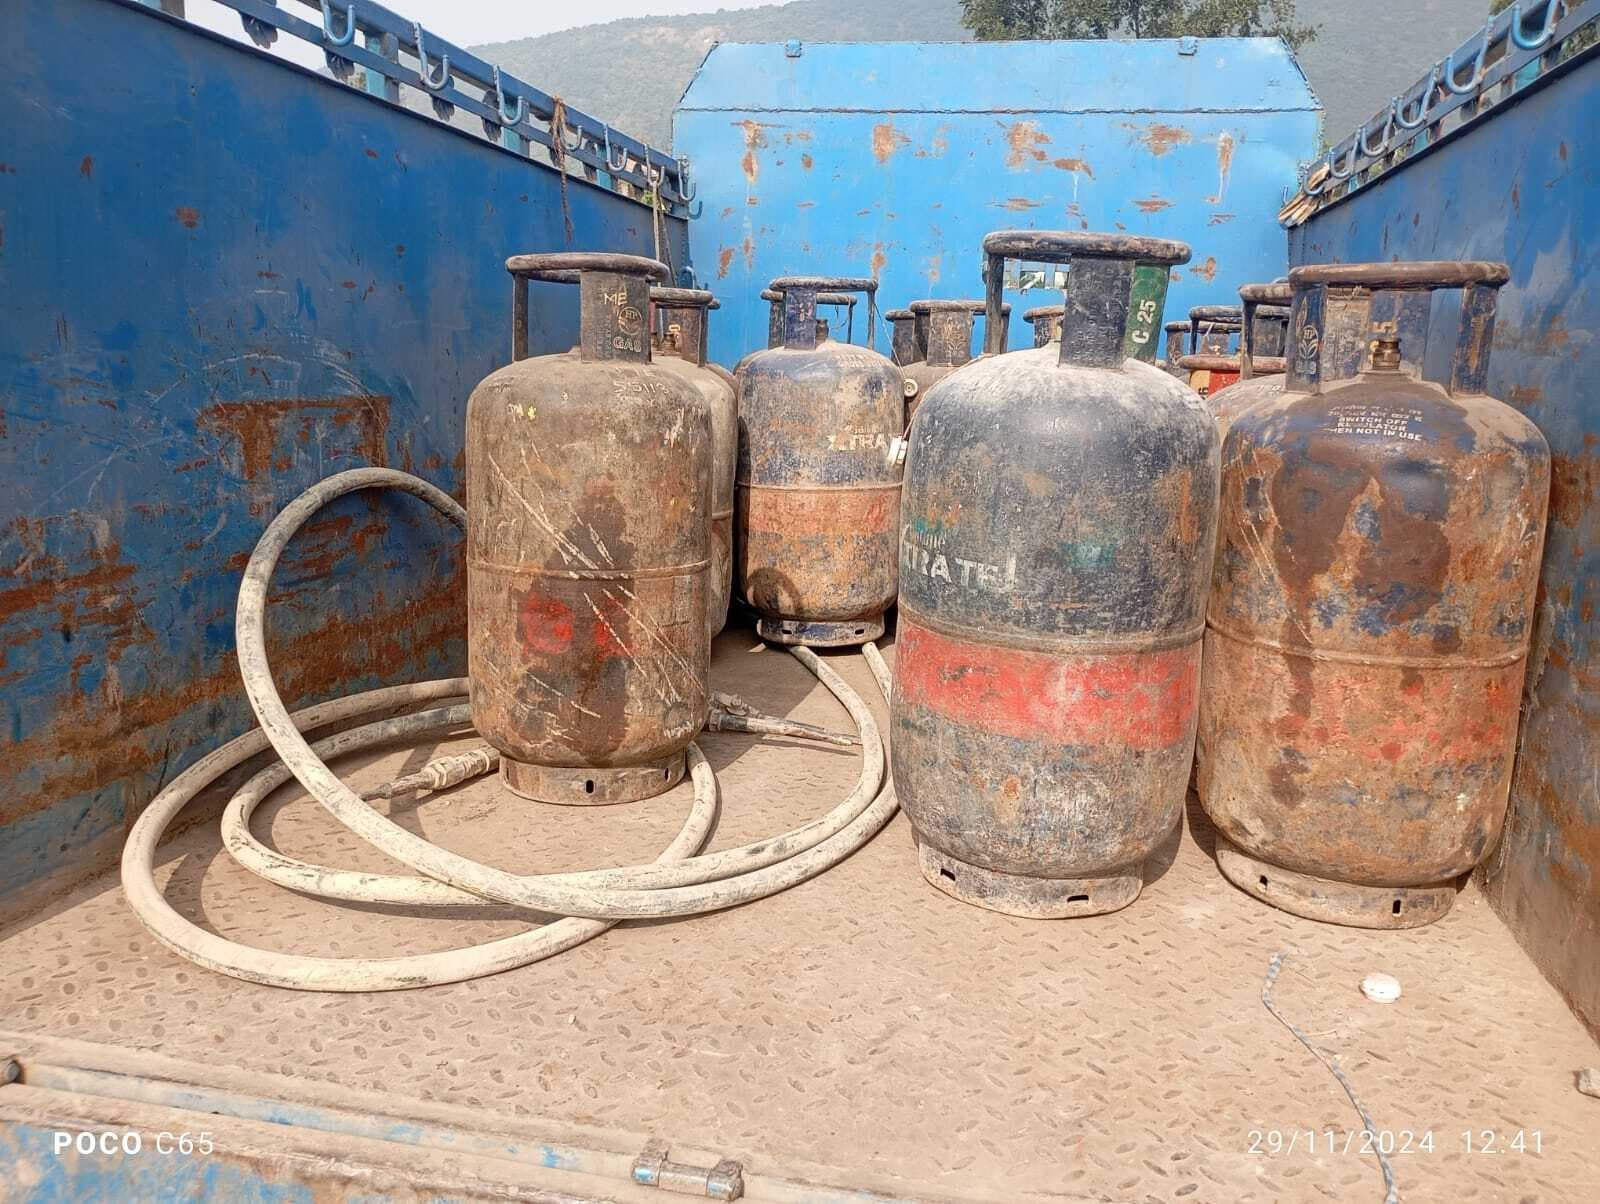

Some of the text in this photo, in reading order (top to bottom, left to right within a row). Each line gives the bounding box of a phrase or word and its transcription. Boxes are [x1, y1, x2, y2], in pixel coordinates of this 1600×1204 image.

[1136, 299, 1156, 324] 25
[1385, 418, 1408, 426] OFF
[1355, 427, 1381, 436] NOT
[1382, 429, 1396, 437] IN
[1398, 431, 1423, 441] USE
